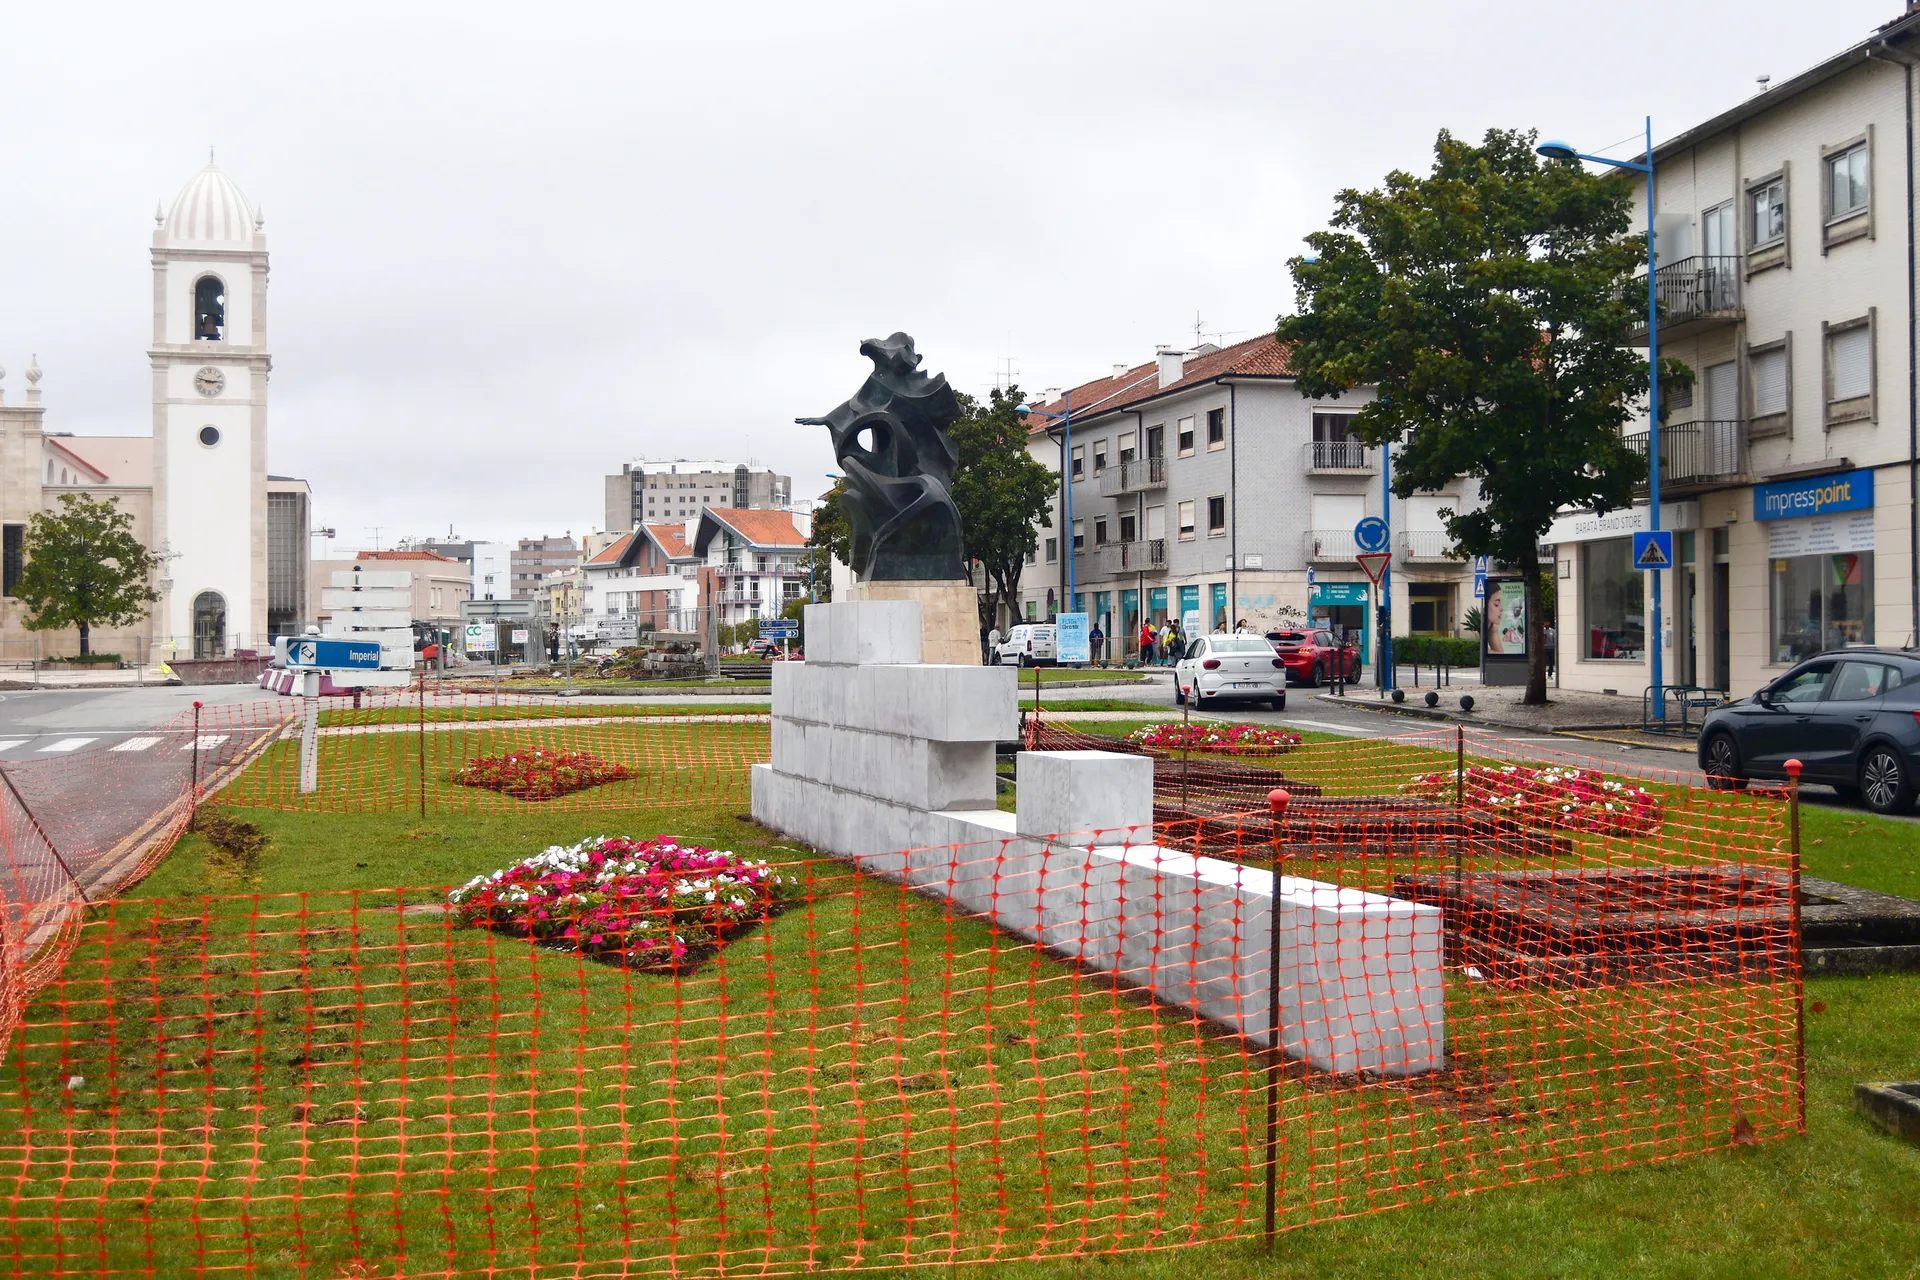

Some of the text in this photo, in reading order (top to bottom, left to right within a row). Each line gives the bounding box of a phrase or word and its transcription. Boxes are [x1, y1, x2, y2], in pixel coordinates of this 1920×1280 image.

[1765, 480, 1851, 515] impresspoint
[1575, 514, 1642, 535] BARATA BRAND STORE
[466, 625, 482, 636] CC
[349, 649, 379, 663] Imperial
